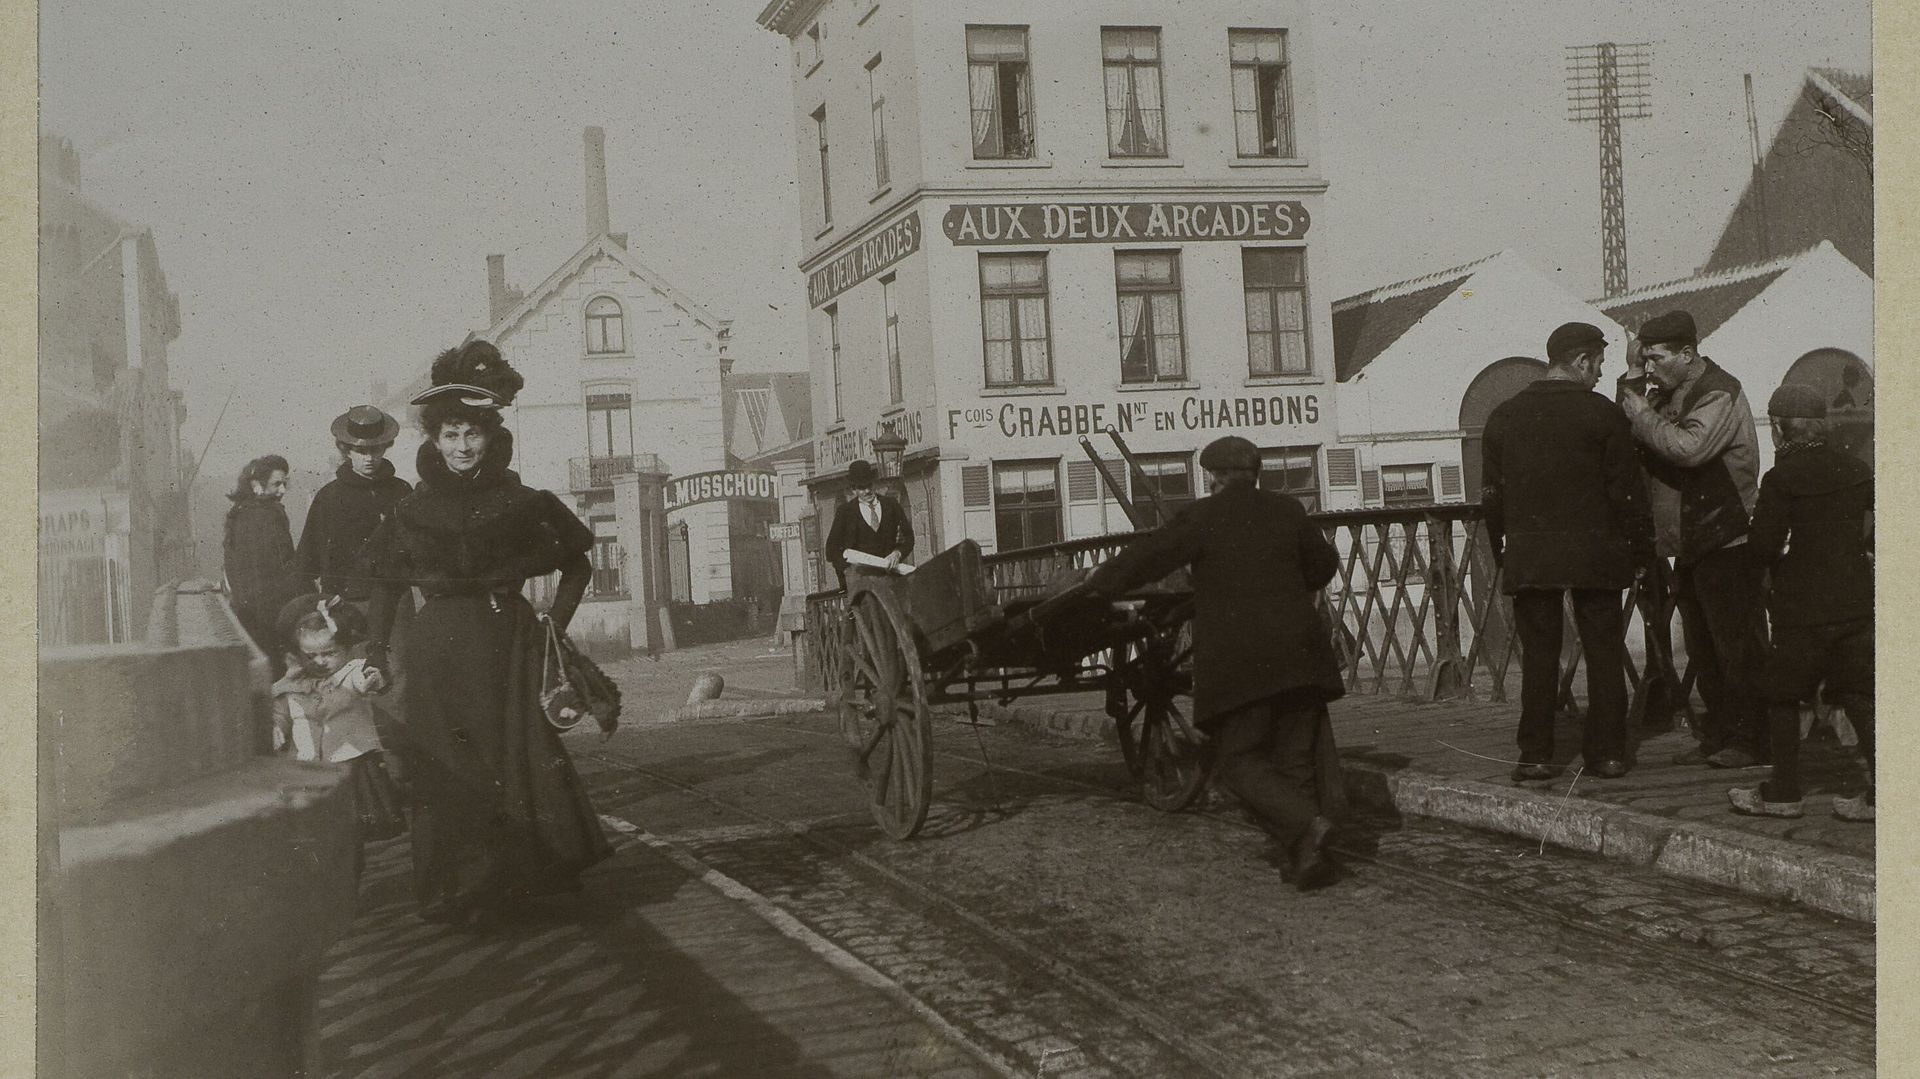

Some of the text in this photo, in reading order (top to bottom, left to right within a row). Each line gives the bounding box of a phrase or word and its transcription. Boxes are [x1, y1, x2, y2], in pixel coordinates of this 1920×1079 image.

[958, 203, 1294, 240] AUX DEUX ARCADES
[813, 219, 913, 304] AUX DEUX ARCADES
[999, 403, 1107, 438] CRABBE
[1154, 411, 1176, 431] EN
[1181, 395, 1320, 430] CHARBONS
